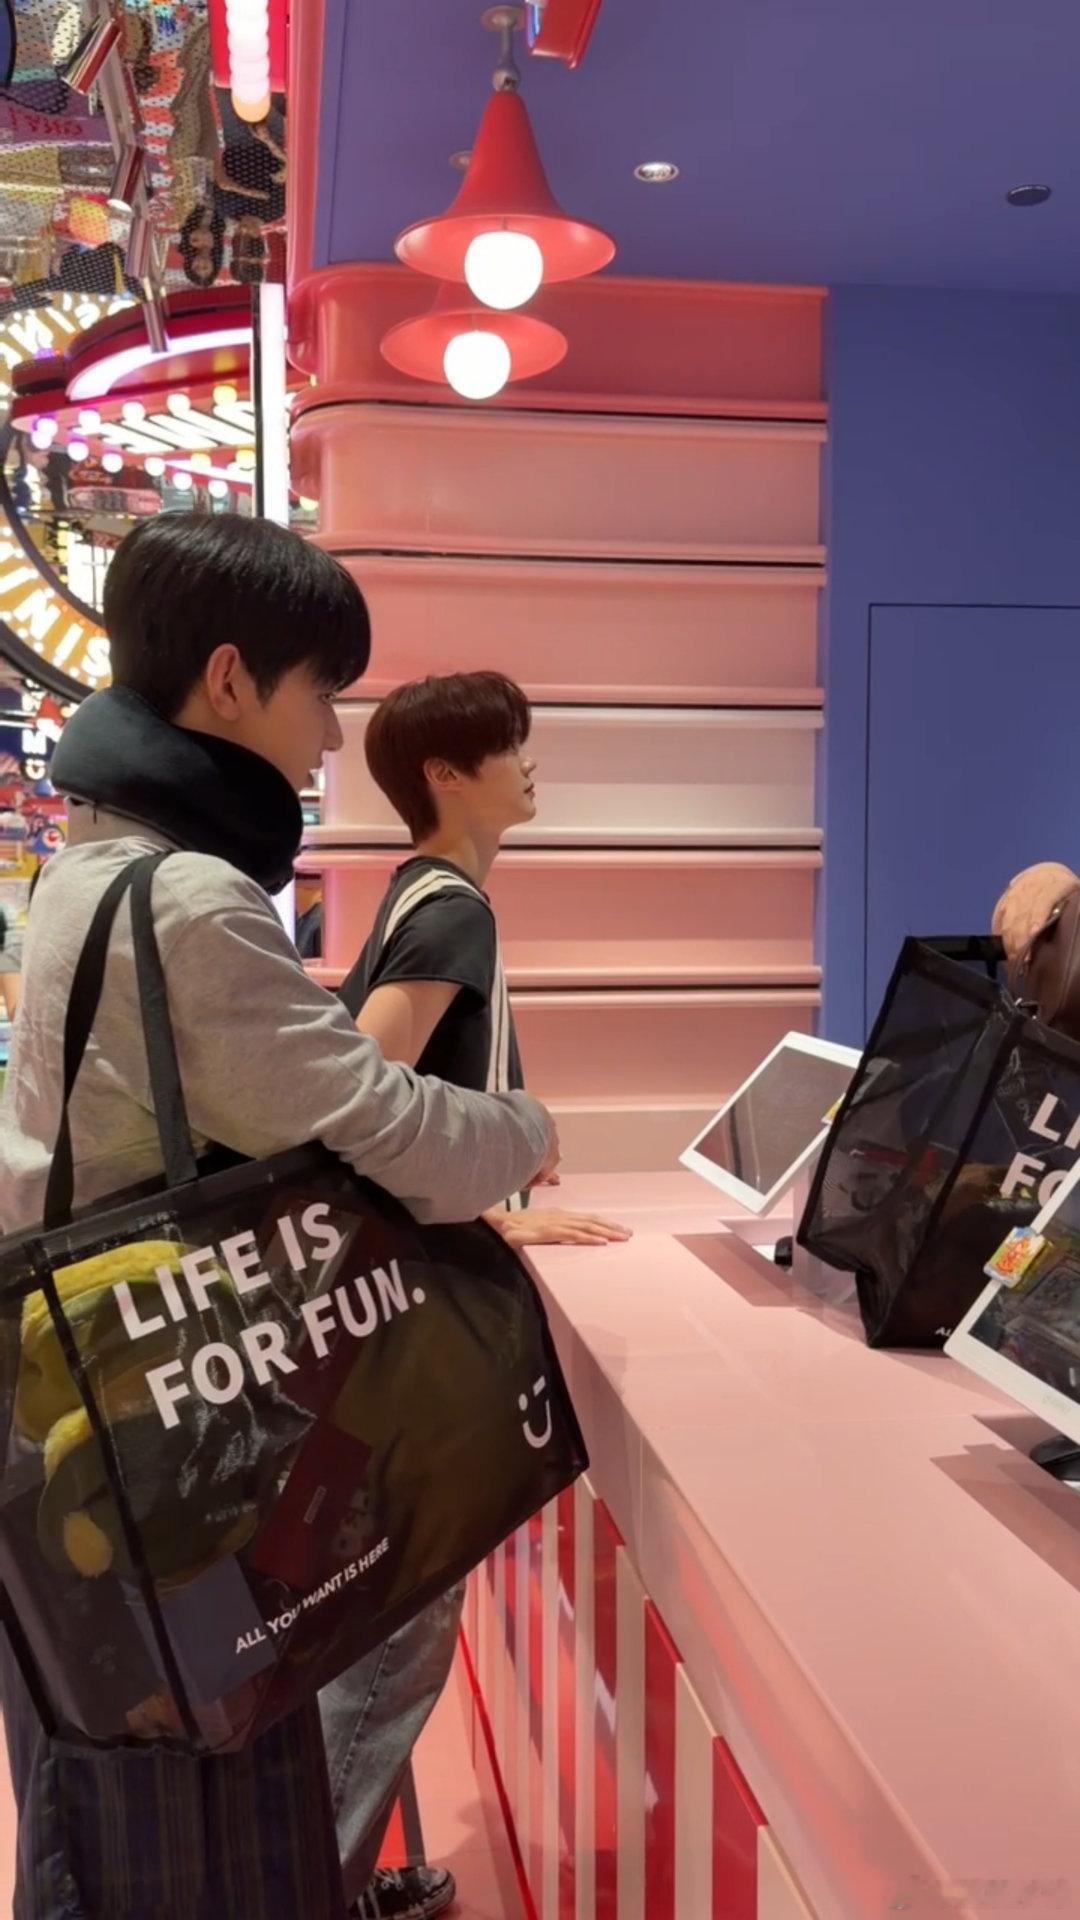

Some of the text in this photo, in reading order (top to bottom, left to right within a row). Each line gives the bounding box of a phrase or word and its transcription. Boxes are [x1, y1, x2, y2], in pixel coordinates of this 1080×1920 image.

[112, 1202, 342, 1341] LIFE IS
[145, 1258, 426, 1430] FOR FUN.
[235, 1536, 390, 1654] ALL YOU WANT IS HERE
